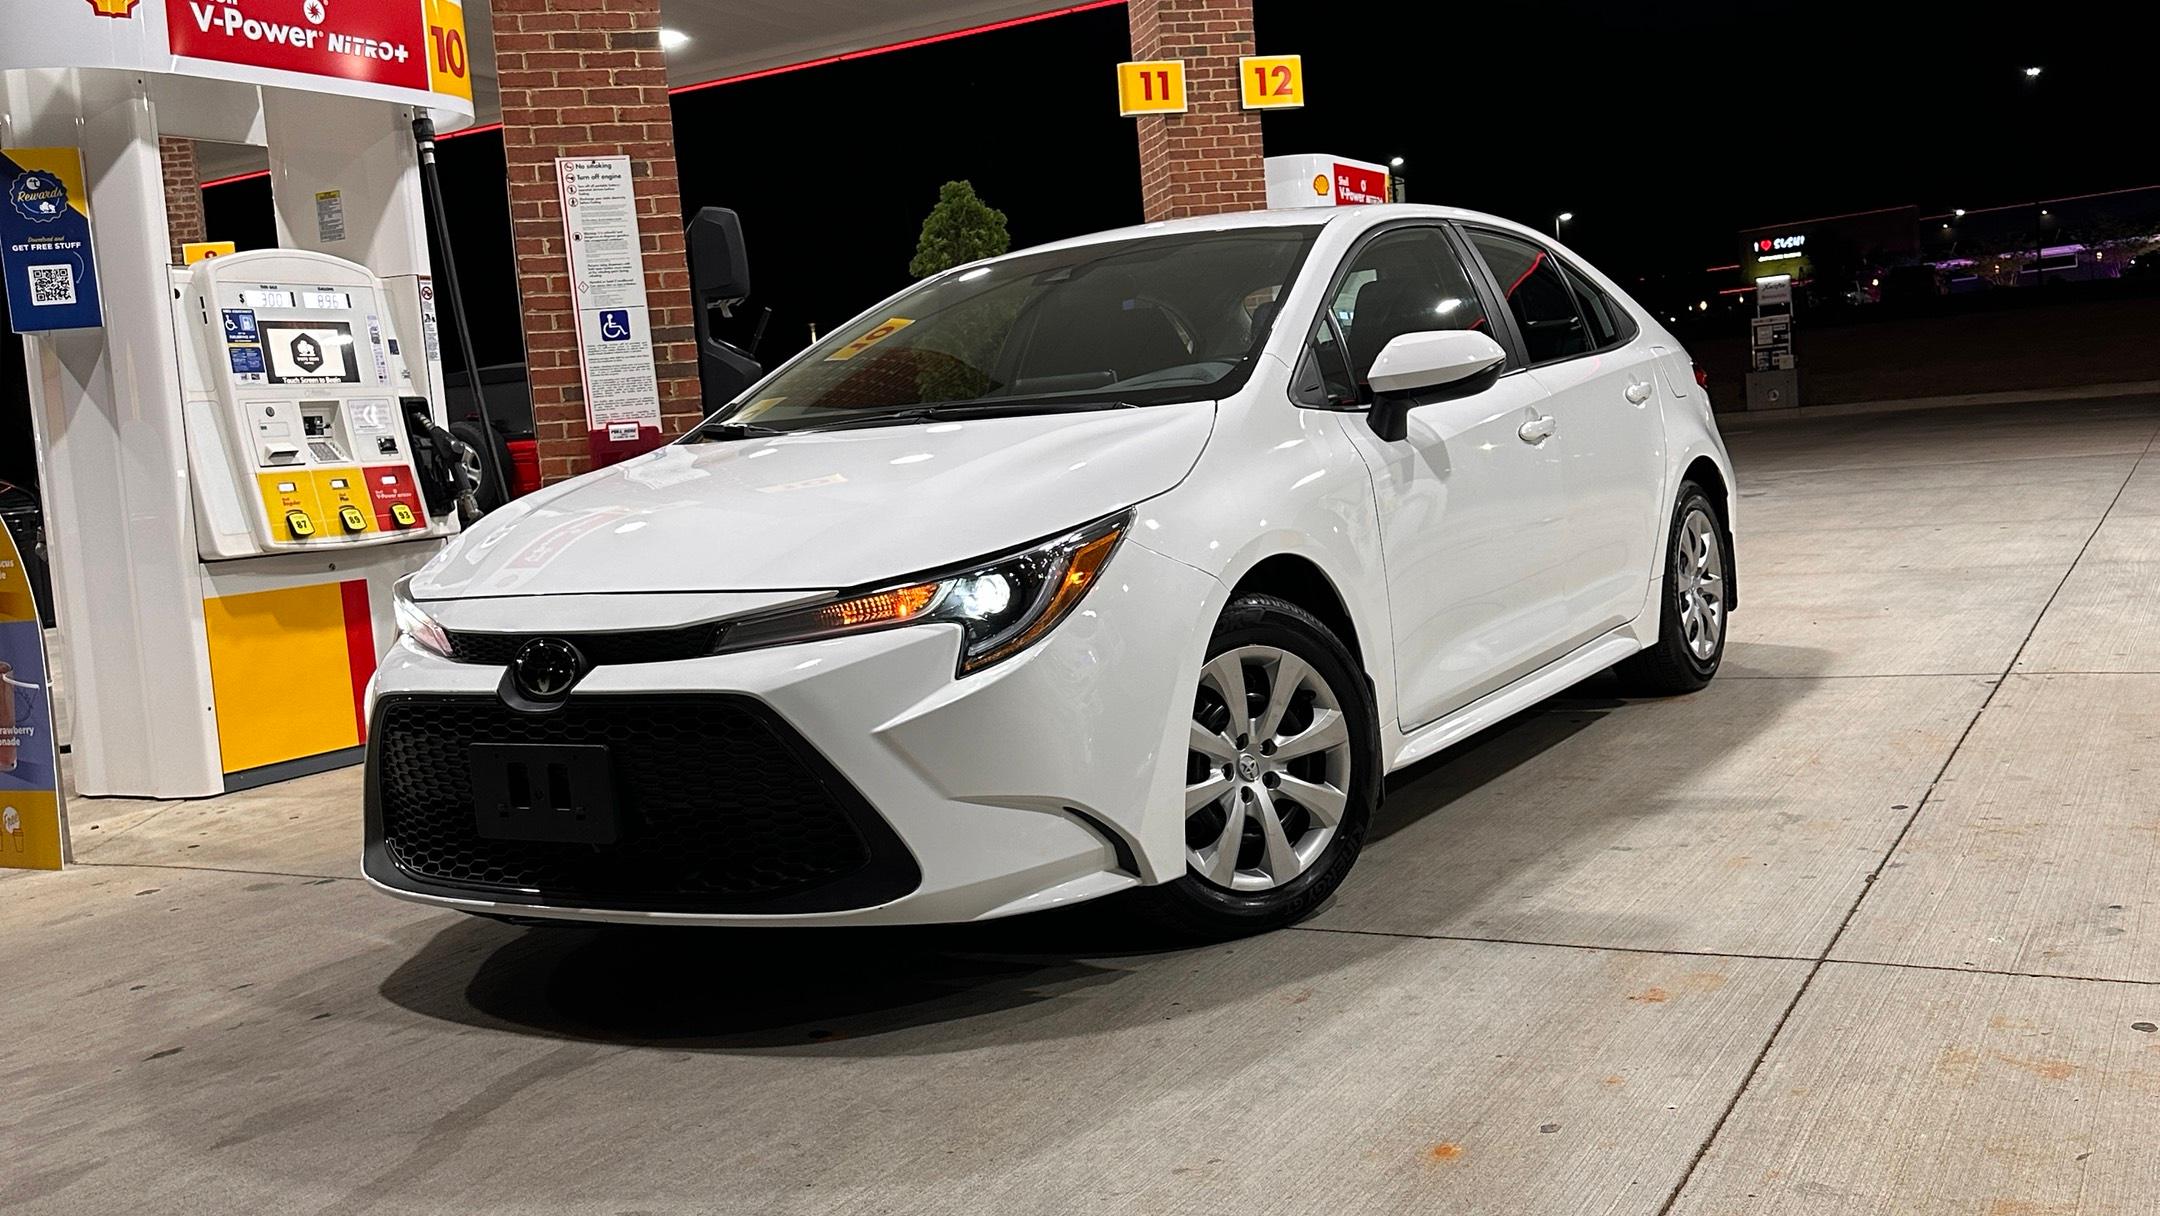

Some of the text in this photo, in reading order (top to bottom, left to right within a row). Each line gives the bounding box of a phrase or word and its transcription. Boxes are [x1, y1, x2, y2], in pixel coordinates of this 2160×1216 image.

[189, 1, 318, 49] V-Power
[430, 25, 465, 78] 10
[1140, 71, 1170, 101] 11
[1254, 65, 1293, 96] 12
[586, 162, 612, 170] smoking
[17, 186, 63, 202] Rewards
[12, 241, 82, 252] GET FREE STUFF
[1773, 235, 1805, 250] SUSHI
[348, 515, 361, 524] 89
[398, 510, 411, 519] 93
[295, 520, 308, 529] 87
